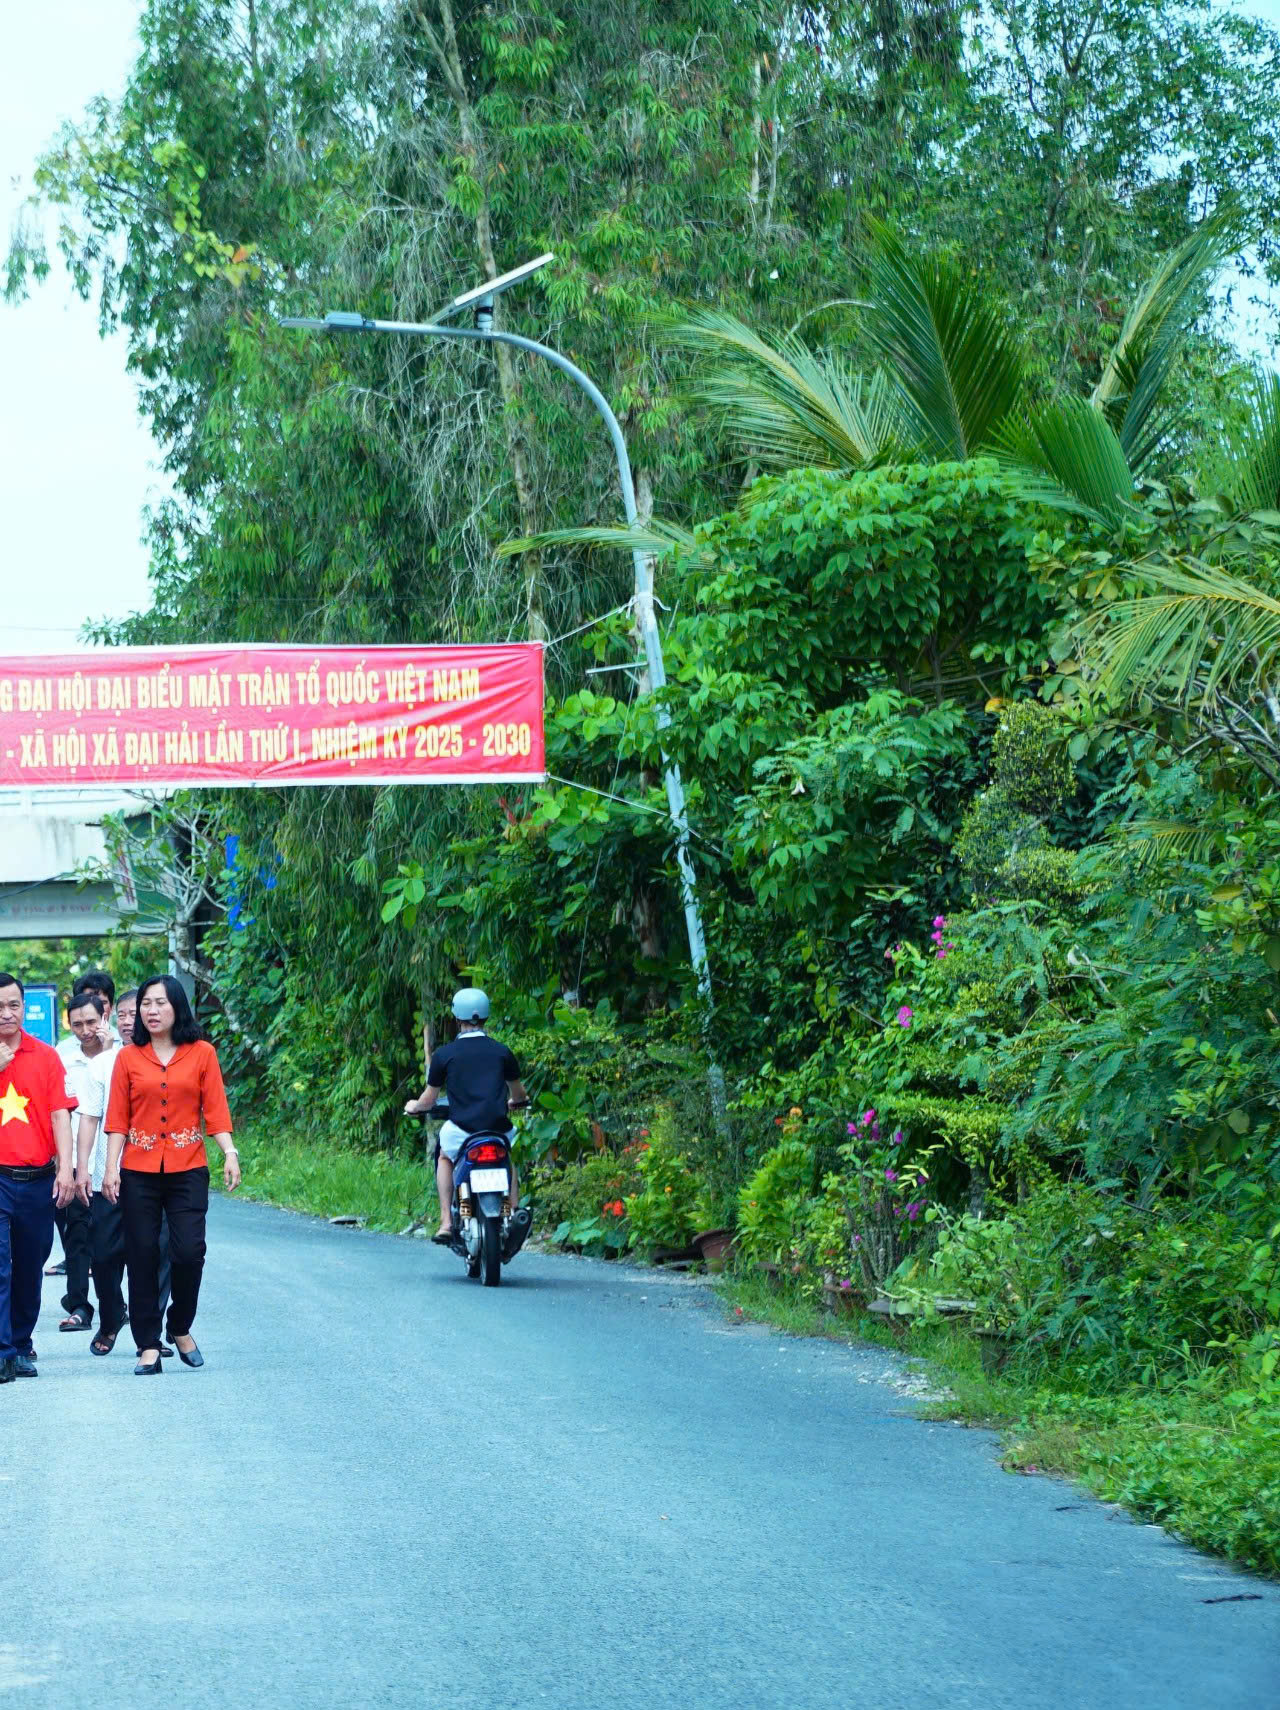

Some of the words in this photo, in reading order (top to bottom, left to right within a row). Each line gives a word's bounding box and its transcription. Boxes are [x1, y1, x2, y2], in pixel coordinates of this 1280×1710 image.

[18, 679, 52, 718] ĐẠI
[58, 672, 91, 717] HỘI
[96, 676, 131, 717] ĐẠI
[137, 663, 182, 709] BIỂU
[189, 668, 232, 714] MẶT
[237, 666, 290, 713] TRẬN
[296, 657, 320, 704] TỔ
[326, 658, 379, 708] QUỐC
[385, 663, 427, 710] VIỆT
[433, 668, 480, 702] NAM
[20, 728, 47, 768] XÃ
[52, 727, 86, 774] HỘI
[92, 726, 120, 767] XÃ
[125, 731, 158, 773] ĐẠI
[165, 719, 198, 765] HẢI
[249, 722, 289, 762] THỨ
[292, 729, 306, 765] I,
[312, 720, 377, 767] NHIỆM
[384, 720, 408, 758] KỲ
[415, 724, 463, 758] 2025
[482, 723, 531, 757] 2030
